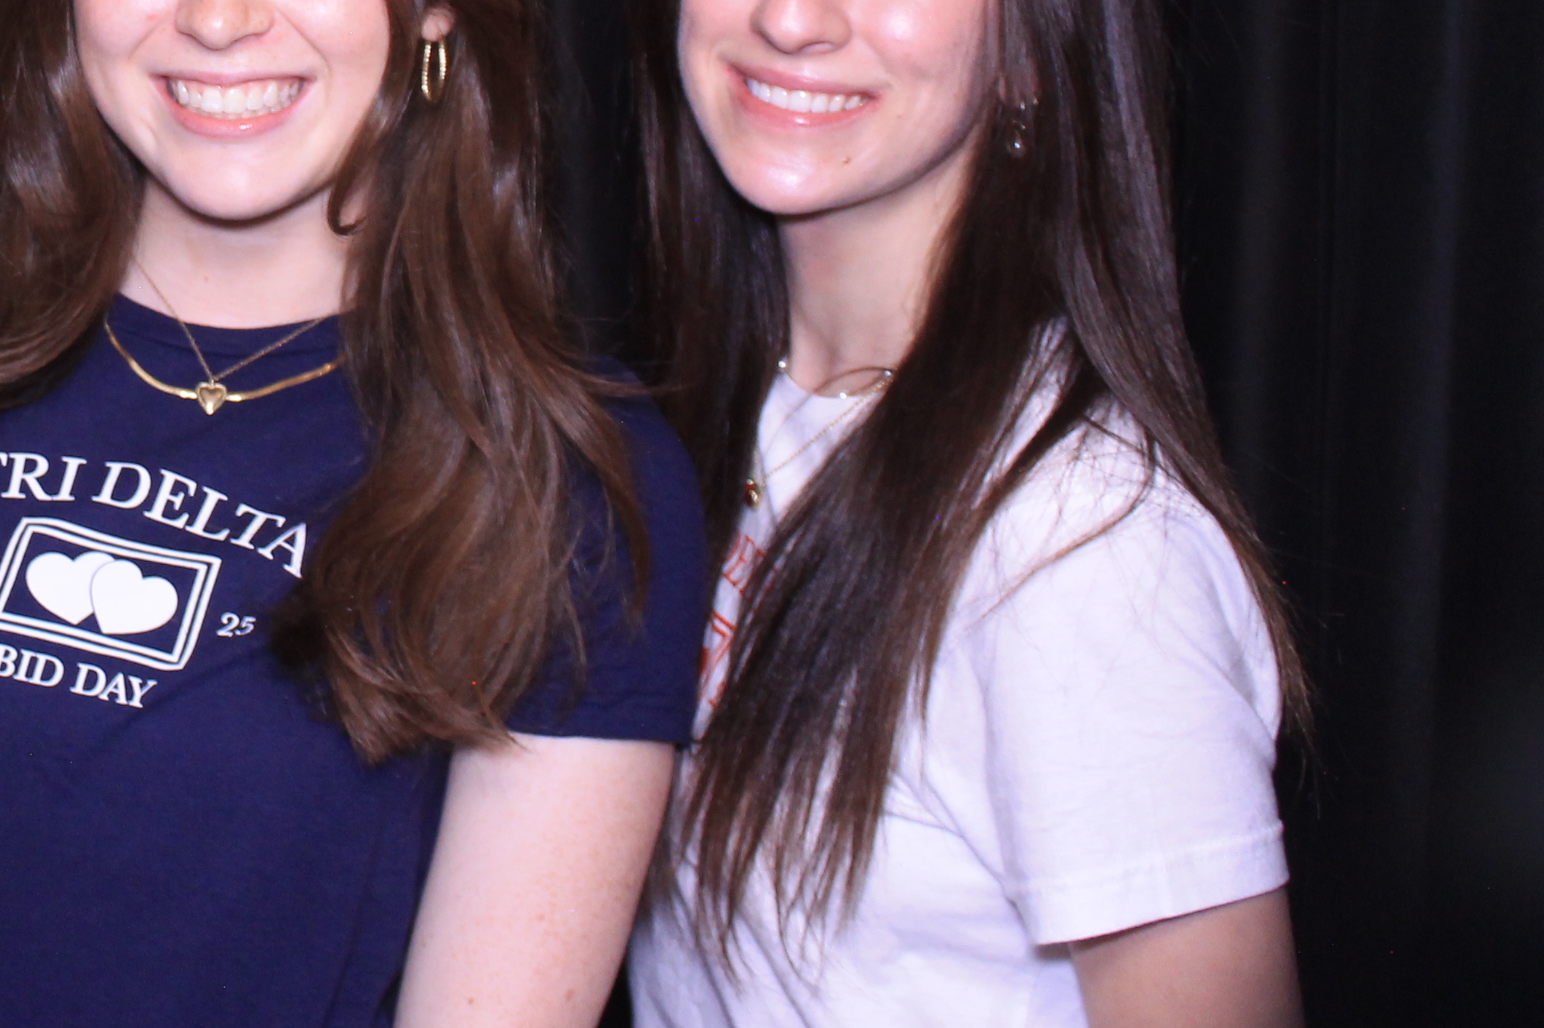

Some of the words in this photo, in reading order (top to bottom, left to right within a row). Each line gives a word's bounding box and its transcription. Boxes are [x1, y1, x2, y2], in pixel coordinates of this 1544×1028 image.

[91, 460, 308, 579] DELTA
[216, 612, 257, 638] 25
[69, 662, 158, 709] DAY
